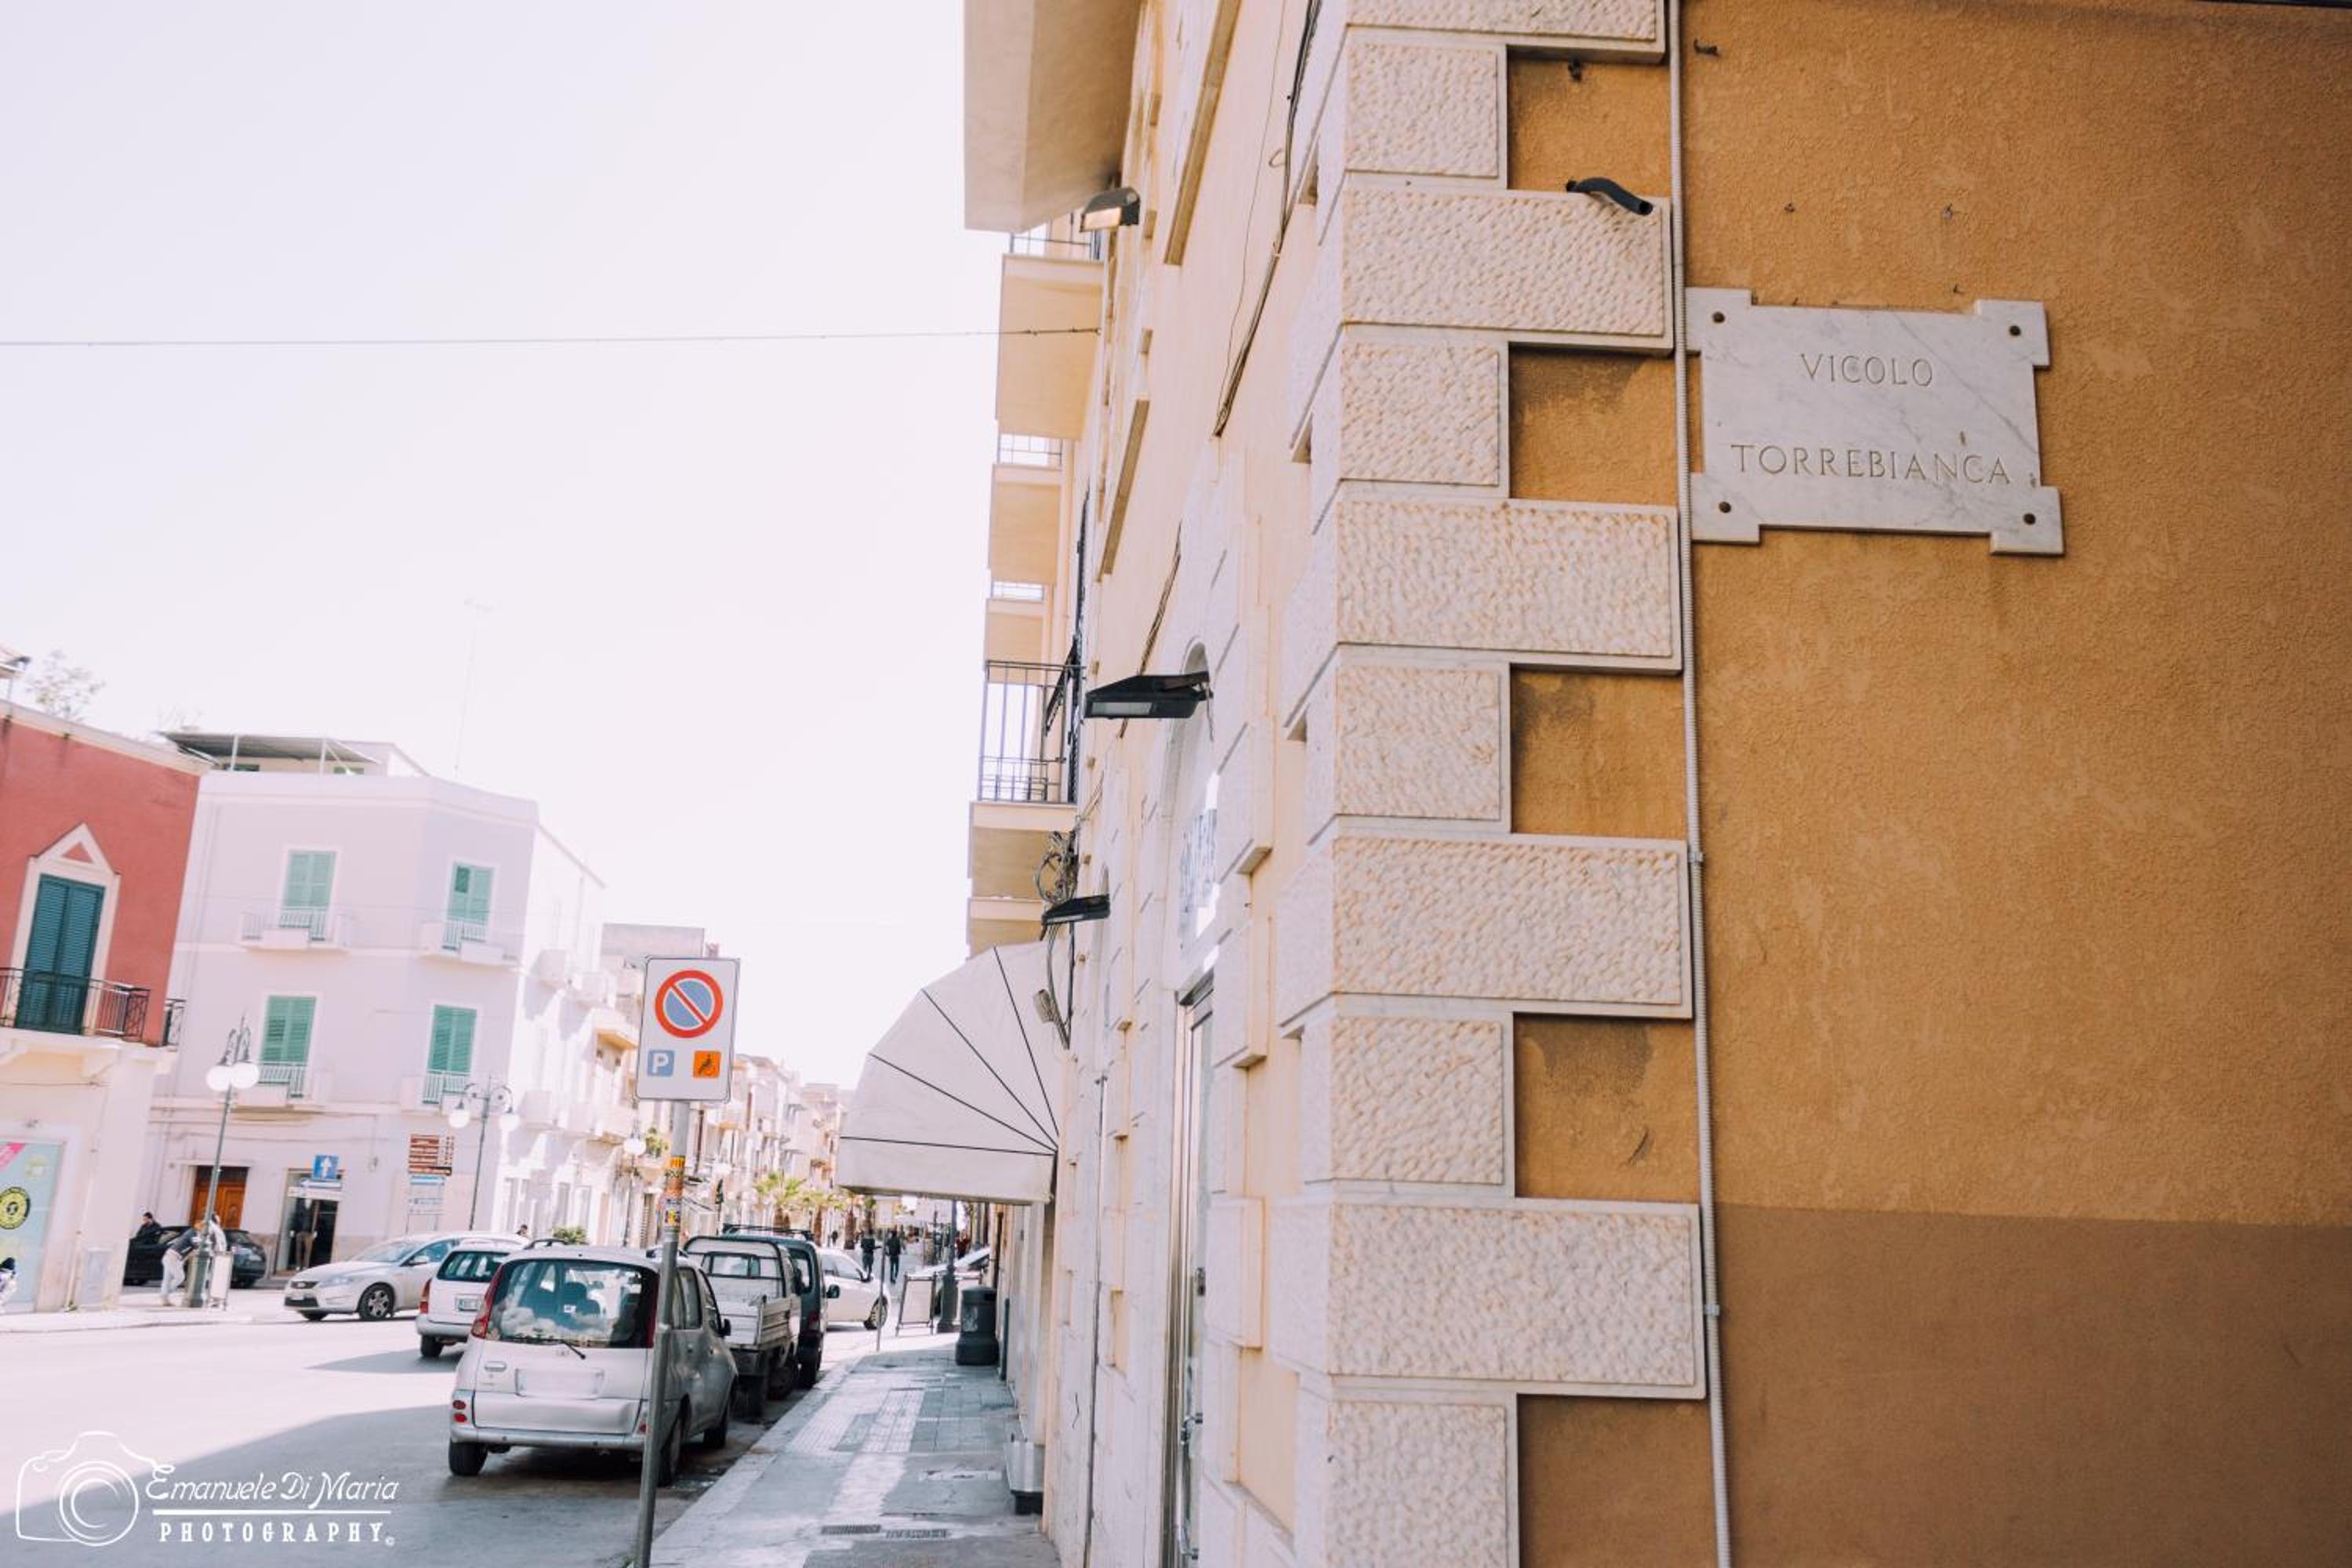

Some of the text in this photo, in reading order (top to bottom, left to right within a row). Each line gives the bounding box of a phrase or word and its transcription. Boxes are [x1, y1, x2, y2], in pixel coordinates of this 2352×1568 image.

[1800, 353, 1933, 387] VICOLO
[1731, 444, 2010, 485] TORREBIANCA
[652, 1053, 669, 1074] P
